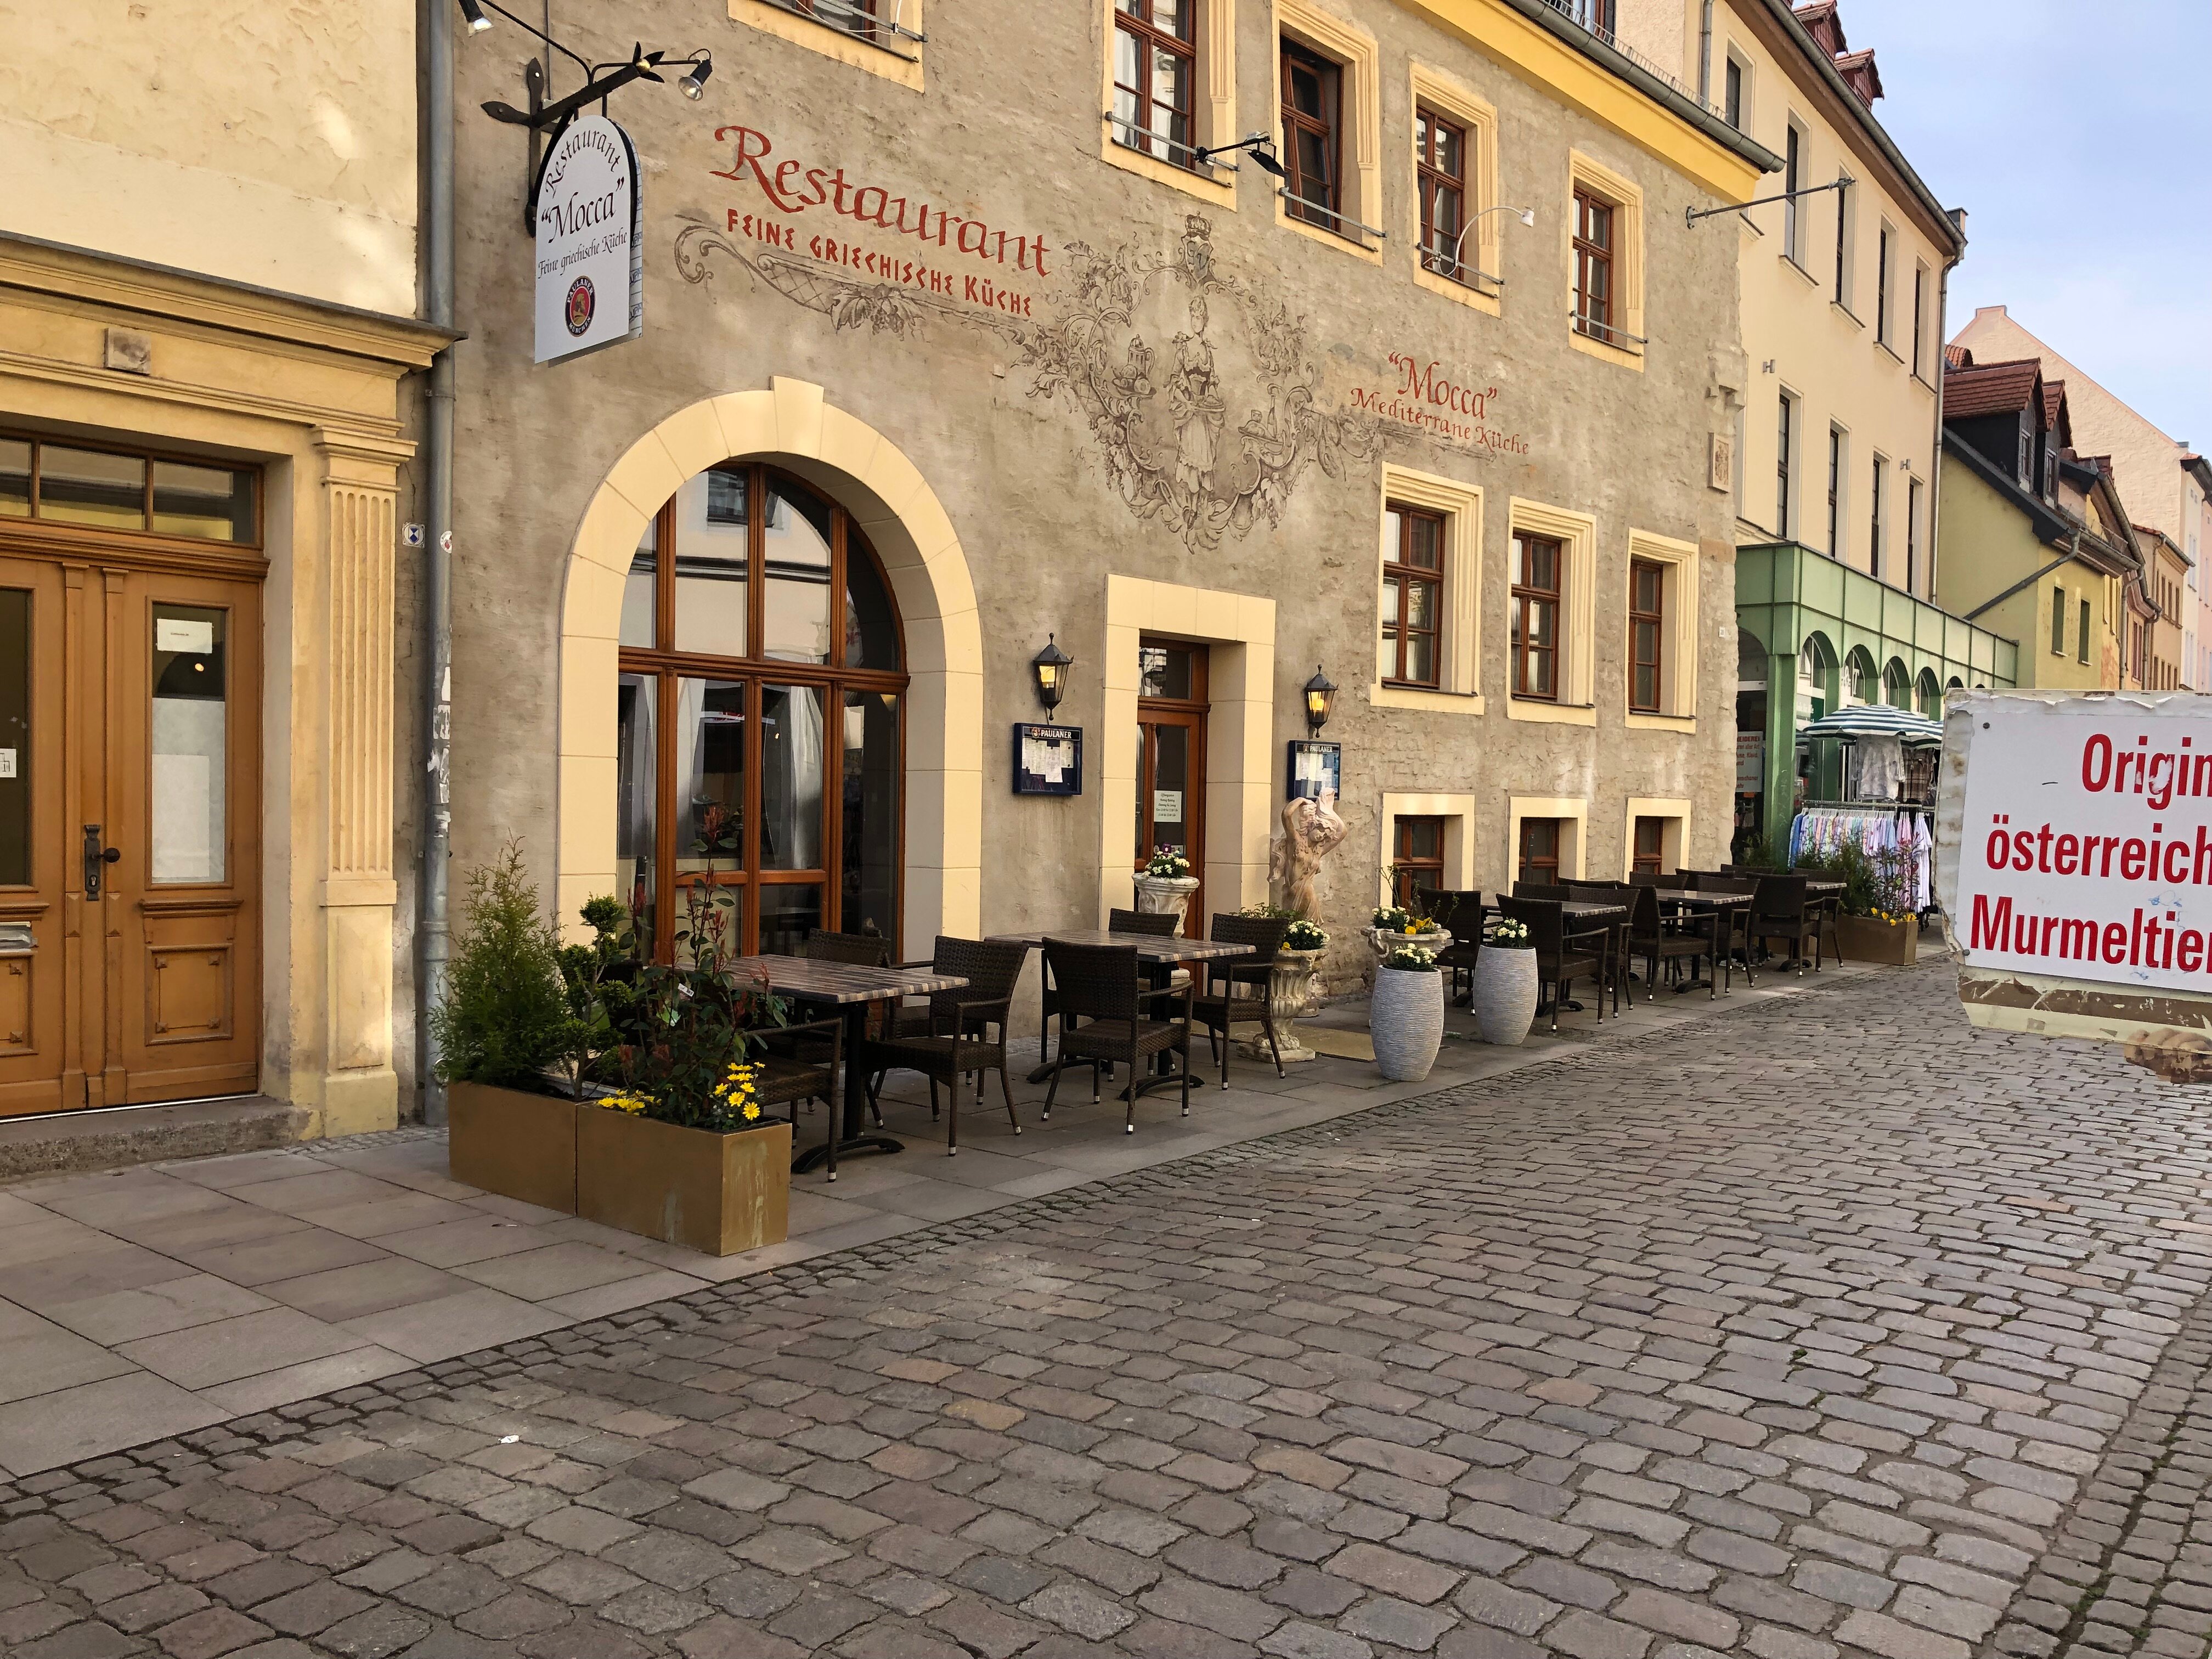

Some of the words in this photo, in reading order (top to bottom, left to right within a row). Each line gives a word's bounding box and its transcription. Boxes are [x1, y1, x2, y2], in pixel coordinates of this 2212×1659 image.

[545, 129, 620, 199] Restaurant
[541, 176, 624, 244] “Mocca”
[709, 125, 1052, 277] Restaurant
[538, 258, 558, 279] Feine
[560, 238, 600, 276] griechische
[602, 227, 628, 253] Küche
[727, 208, 795, 250] FEINE
[810, 234, 954, 297] GRIECHISCHE
[964, 274, 1032, 318] KÜCHE
[567, 278, 594, 303] PAULANER
[1388, 351, 1498, 420] “Mocca”
[1350, 387, 1471, 440] Mediterrane
[1475, 426, 1530, 455] Küche
[1041, 729, 1072, 739] PAULANER
[2082, 733, 2212, 811] Origin
[1987, 814, 2212, 886] österreich
